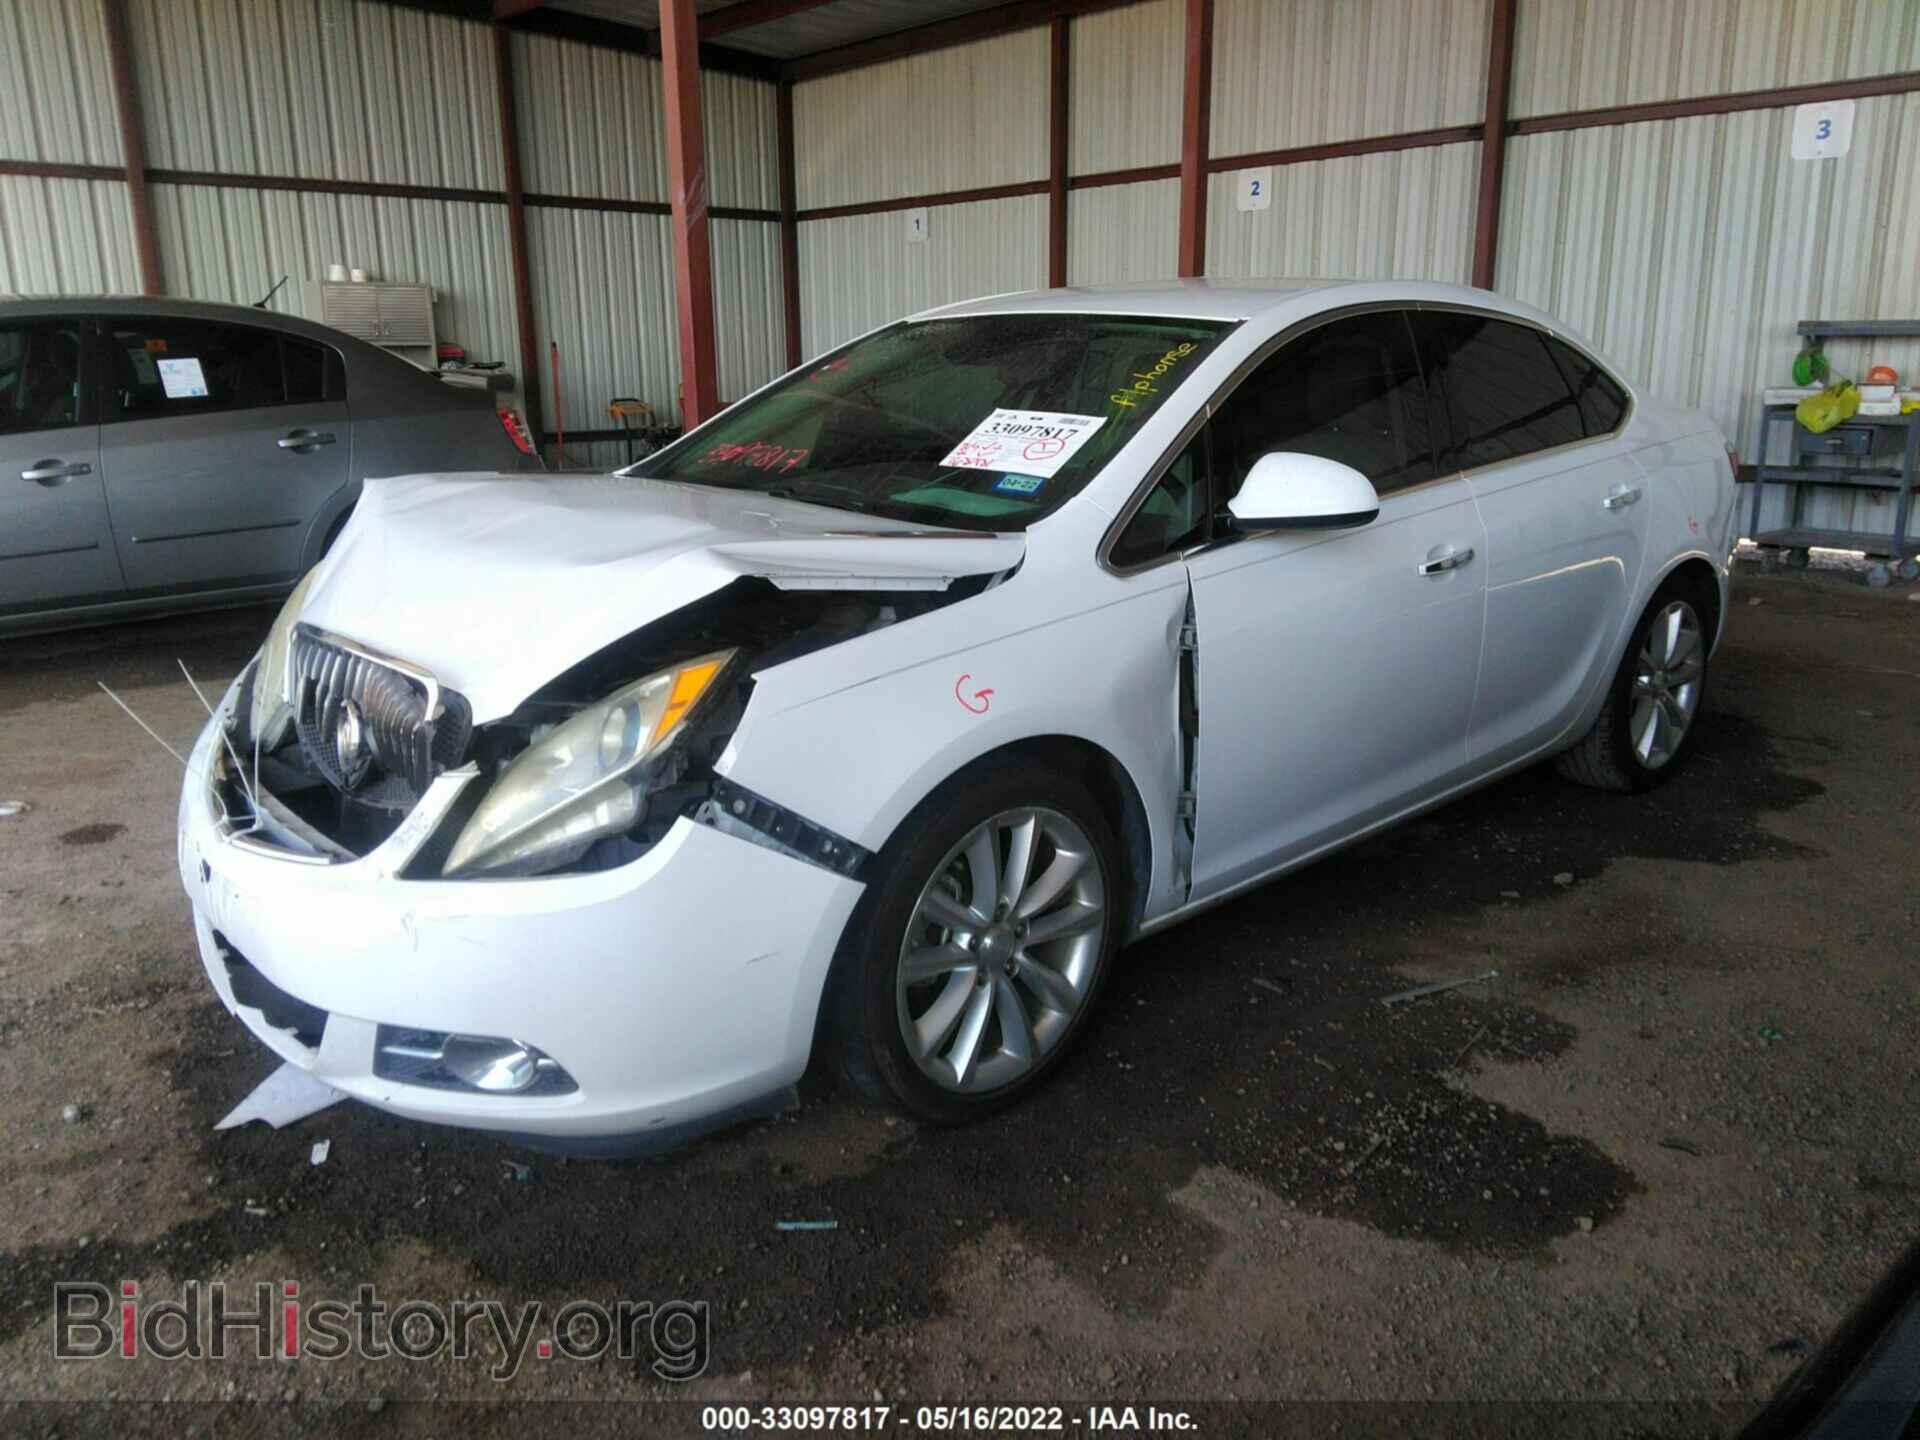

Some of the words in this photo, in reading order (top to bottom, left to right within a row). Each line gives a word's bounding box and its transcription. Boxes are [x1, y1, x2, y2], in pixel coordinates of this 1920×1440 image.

[1815, 119, 1832, 140] 3
[1250, 180, 1260, 196] 2
[914, 218, 920, 231] 1
[984, 421, 1079, 440] 33097817
[954, 673, 994, 714] G
